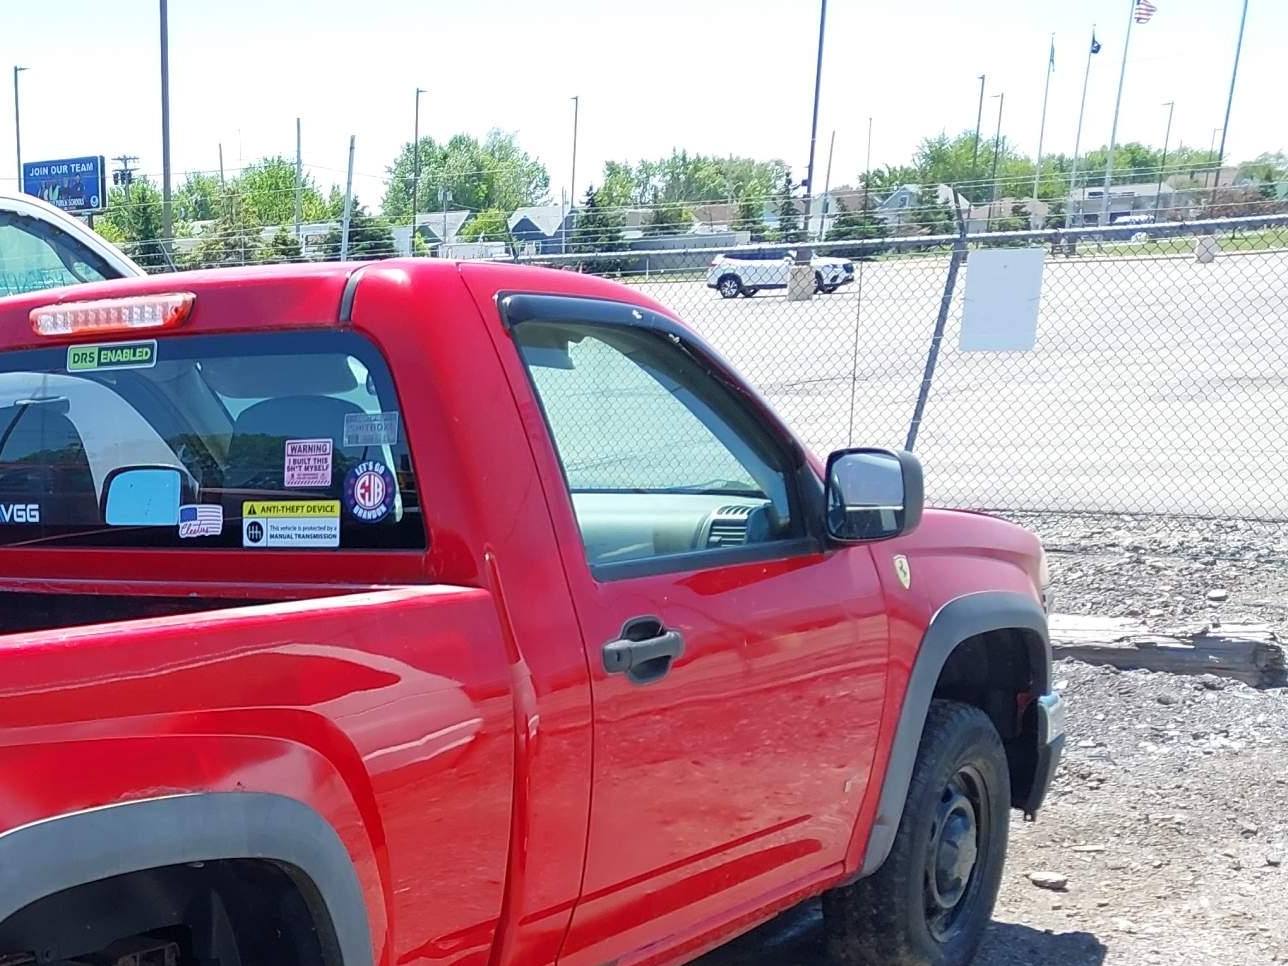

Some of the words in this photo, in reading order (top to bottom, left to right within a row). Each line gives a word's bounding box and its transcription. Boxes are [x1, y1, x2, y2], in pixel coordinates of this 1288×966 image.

[30, 167, 49, 177] JOIN
[51, 165, 68, 174] OUR
[70, 162, 93, 172] TEAM
[73, 352, 95, 364] DRS
[100, 347, 151, 362] ENABLED
[290, 444, 327, 454] WARNING
[304, 464, 329, 472] MYSELF
[354, 461, 373, 476] LET'S
[374, 462, 385, 474] GO
[261, 505, 304, 514] ANTI-THEFT
[306, 505, 335, 513] DEVICE
[353, 503, 387, 519] BRANDON
